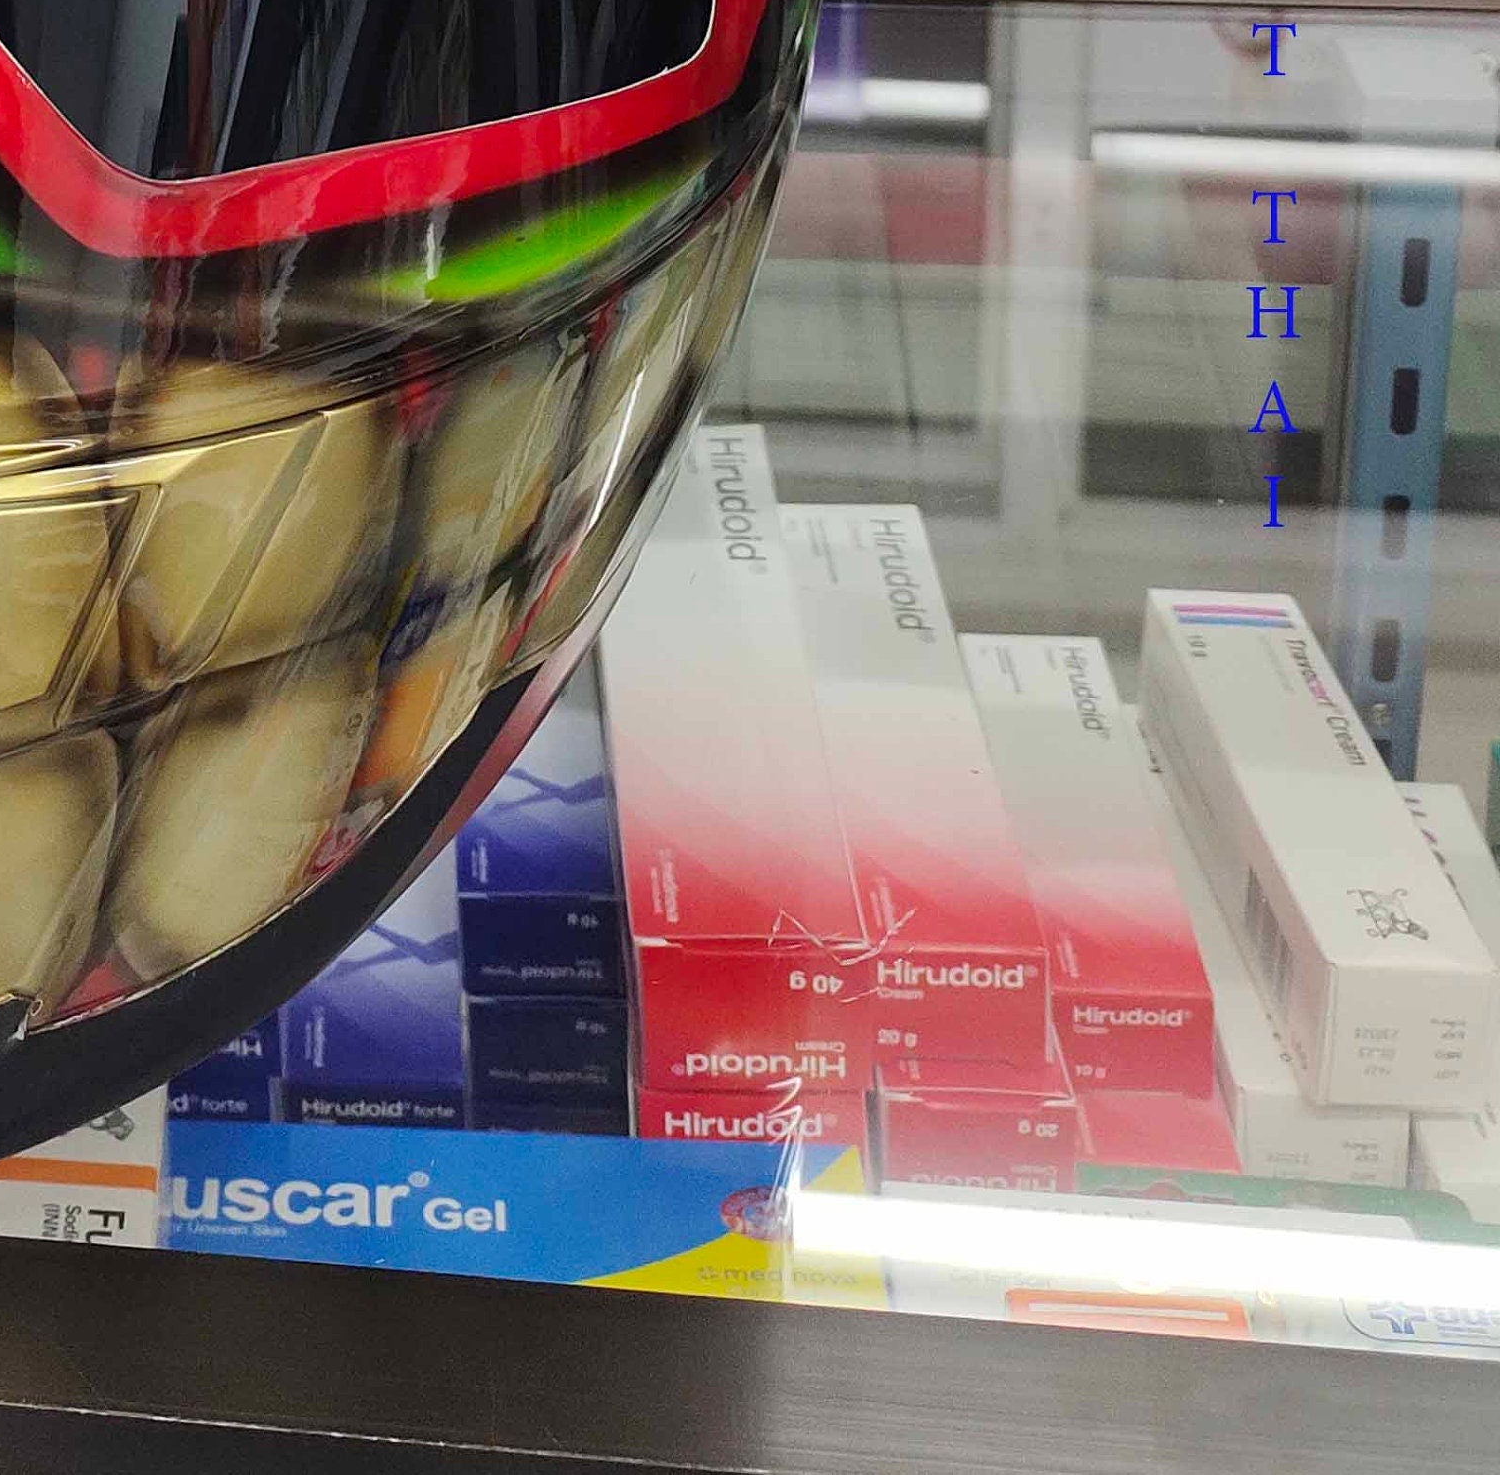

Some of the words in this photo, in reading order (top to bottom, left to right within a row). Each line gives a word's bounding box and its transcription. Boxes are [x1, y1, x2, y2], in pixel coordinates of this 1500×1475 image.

[707, 437, 767, 561] Hirudoid
[870, 519, 934, 630] Hirudoid
[1061, 646, 1111, 731] Hirudoid
[789, 971, 807, 990] g
[812, 974, 844, 995] 40
[876, 960, 1025, 989] Hirudoid
[1073, 1005, 1183, 1027] Hirudoid
[686, 1053, 846, 1078] Hirudoid
[301, 1097, 403, 1118] Hirudoid
[663, 1110, 823, 1138] Hirudoid
[422, 1196, 507, 1232] Gel
[723, 1267, 859, 1286] mednova
